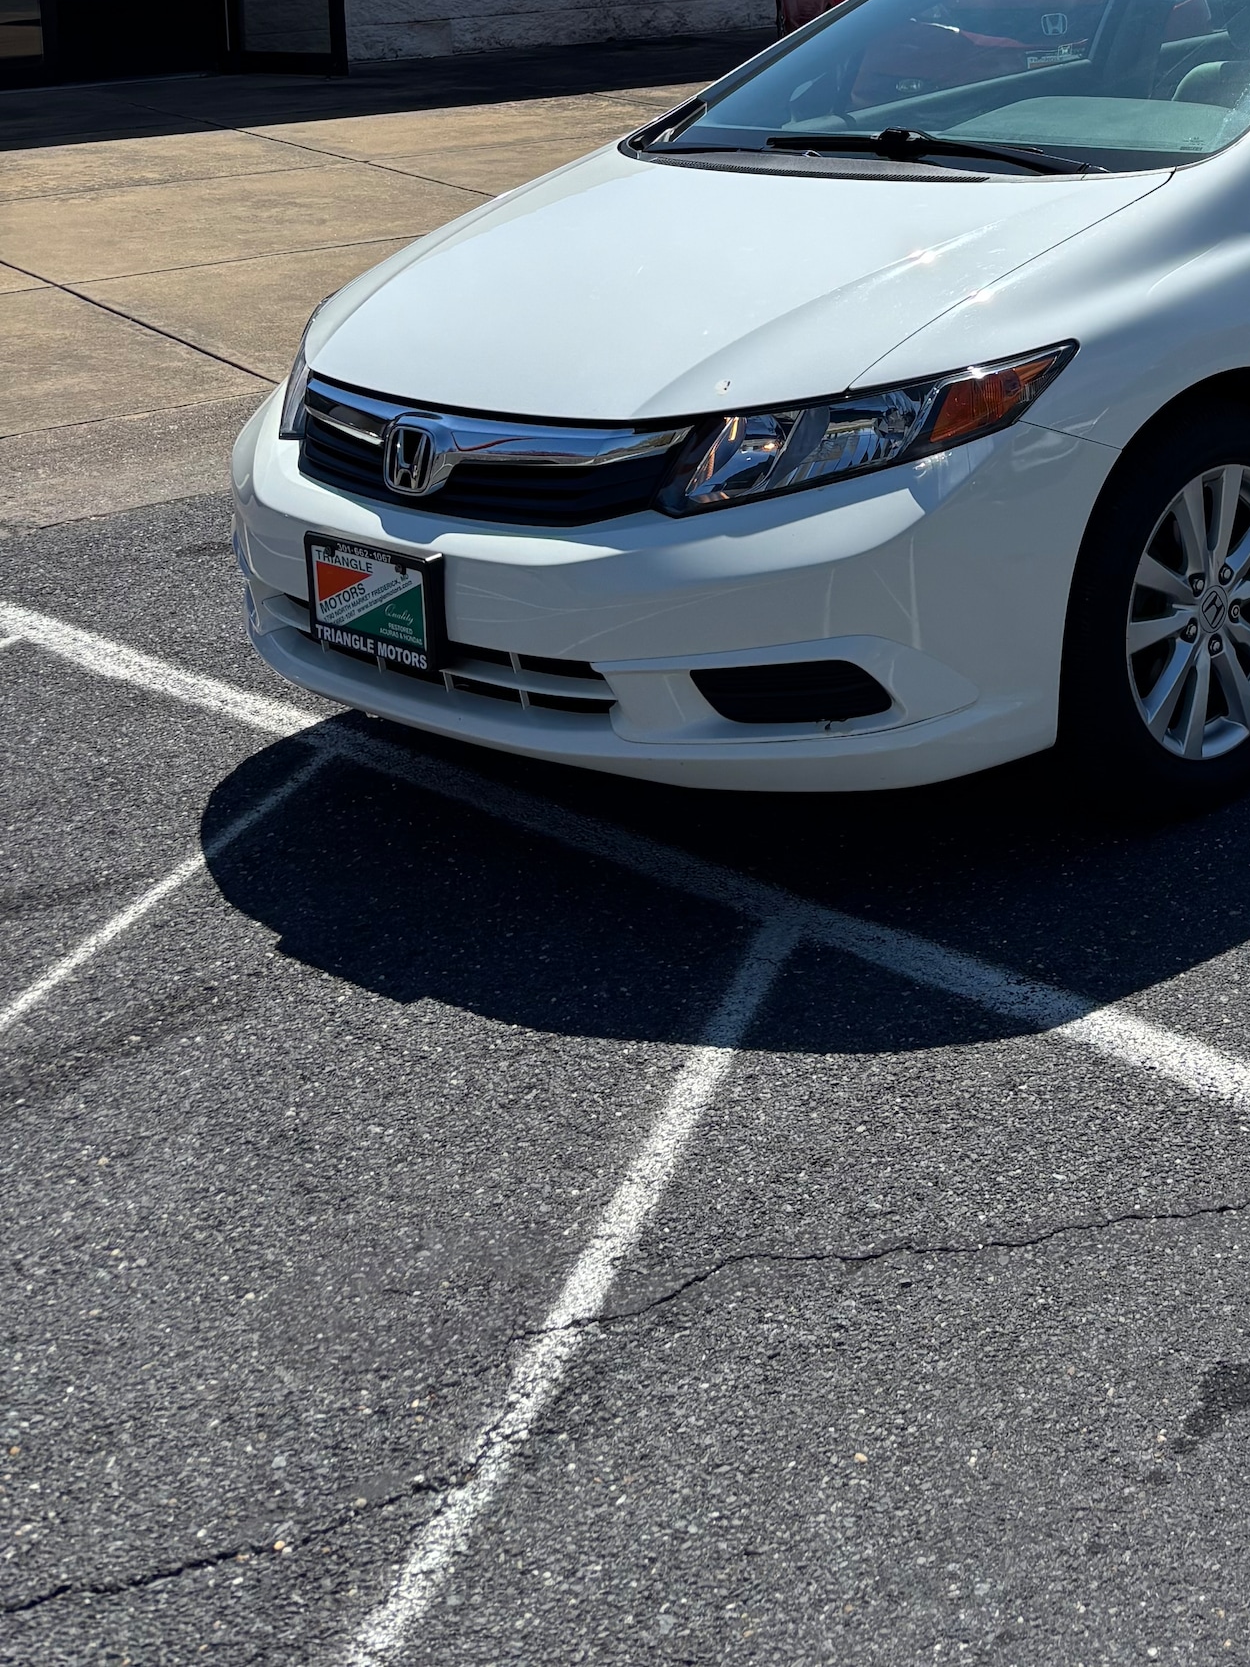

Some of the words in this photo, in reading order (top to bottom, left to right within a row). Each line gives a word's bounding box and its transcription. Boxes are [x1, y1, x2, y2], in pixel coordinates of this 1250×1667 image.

[319, 582, 367, 616] MOTORS
[384, 603, 414, 626] Quality
[315, 623, 375, 655] TRIANGLE
[377, 641, 428, 670] MOTORS
